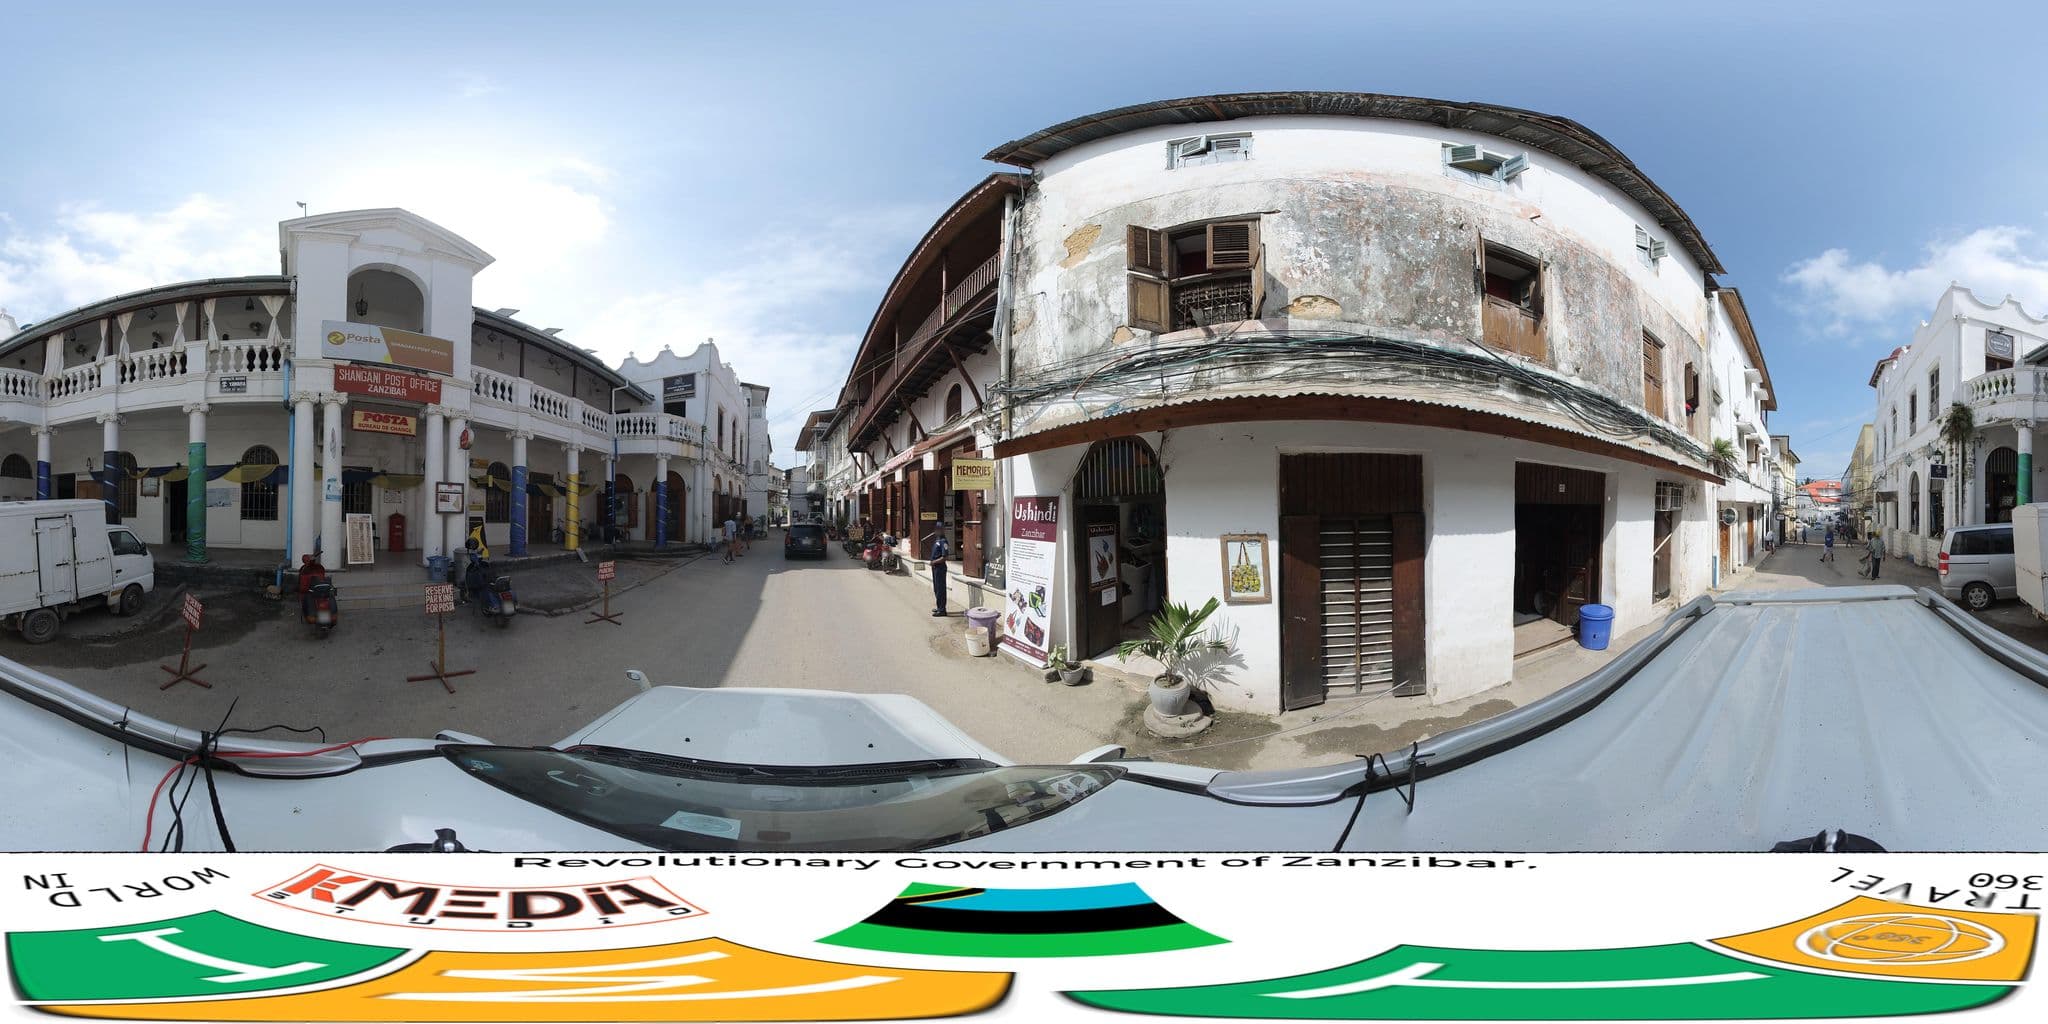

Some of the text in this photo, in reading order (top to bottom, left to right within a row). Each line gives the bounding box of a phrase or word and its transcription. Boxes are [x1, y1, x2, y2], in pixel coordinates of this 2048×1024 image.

[347, 333, 380, 344] Posta
[339, 369, 438, 392] SHANGANI POST OFFICE
[368, 384, 407, 397] ZANZIBAR
[363, 412, 409, 426] POSTA
[358, 422, 381, 430] BUREAU
[956, 465, 991, 476] MEMORIES
[1014, 501, 1057, 522] Ushindi
[426, 584, 454, 595] RESERVE
[426, 593, 454, 604] PARKING
[426, 602, 455, 614] FOR POSTA
